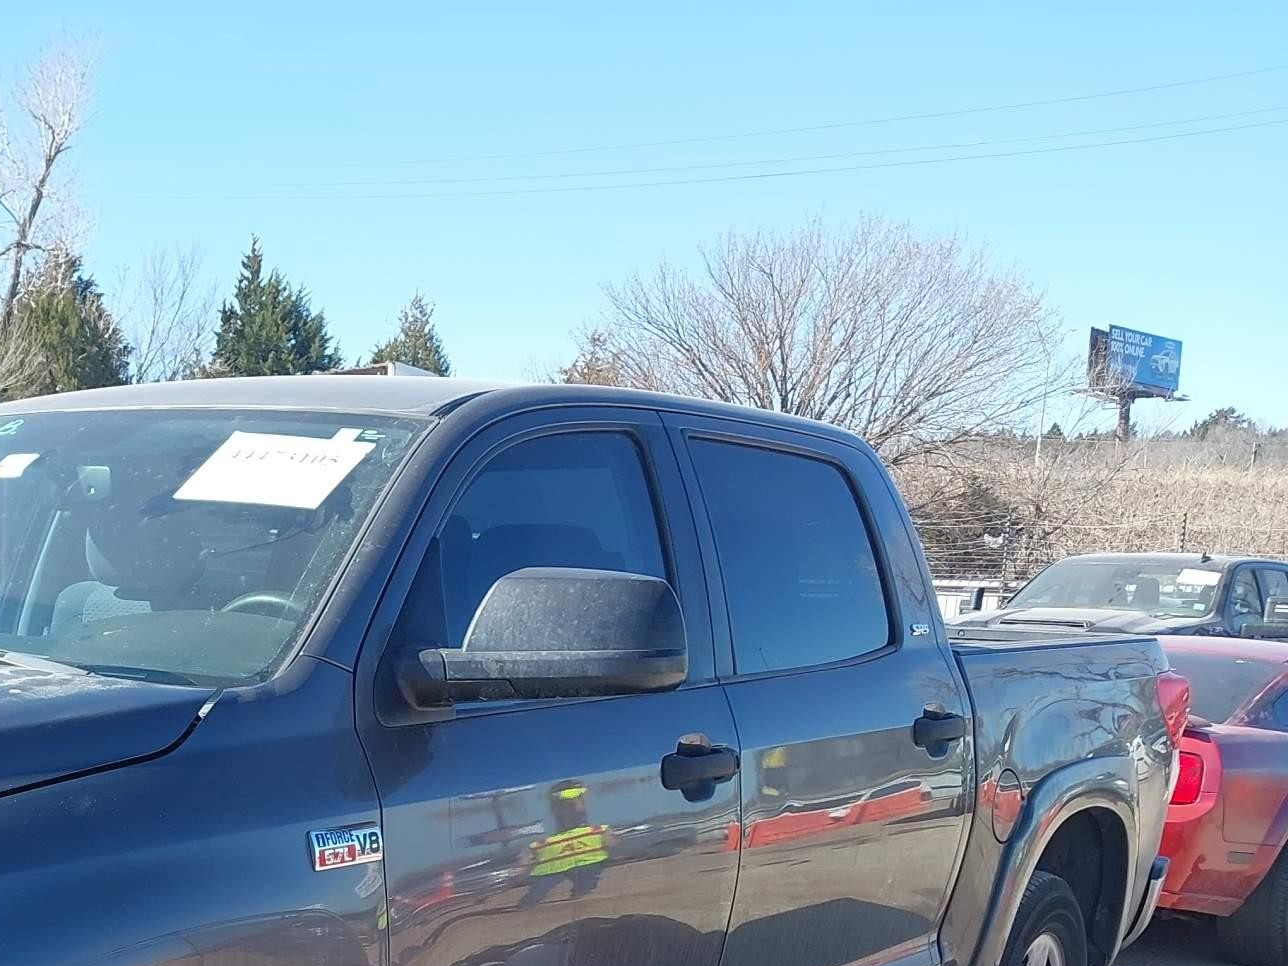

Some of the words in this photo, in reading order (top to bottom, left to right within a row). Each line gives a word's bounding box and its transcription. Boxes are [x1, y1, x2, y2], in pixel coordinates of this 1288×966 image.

[1111, 328, 1125, 340] SELL
[1125, 332, 1140, 344] YOUR
[1141, 335, 1153, 347] CAR
[1124, 344, 1145, 357] ONLINE
[355, 831, 380, 855] V8
